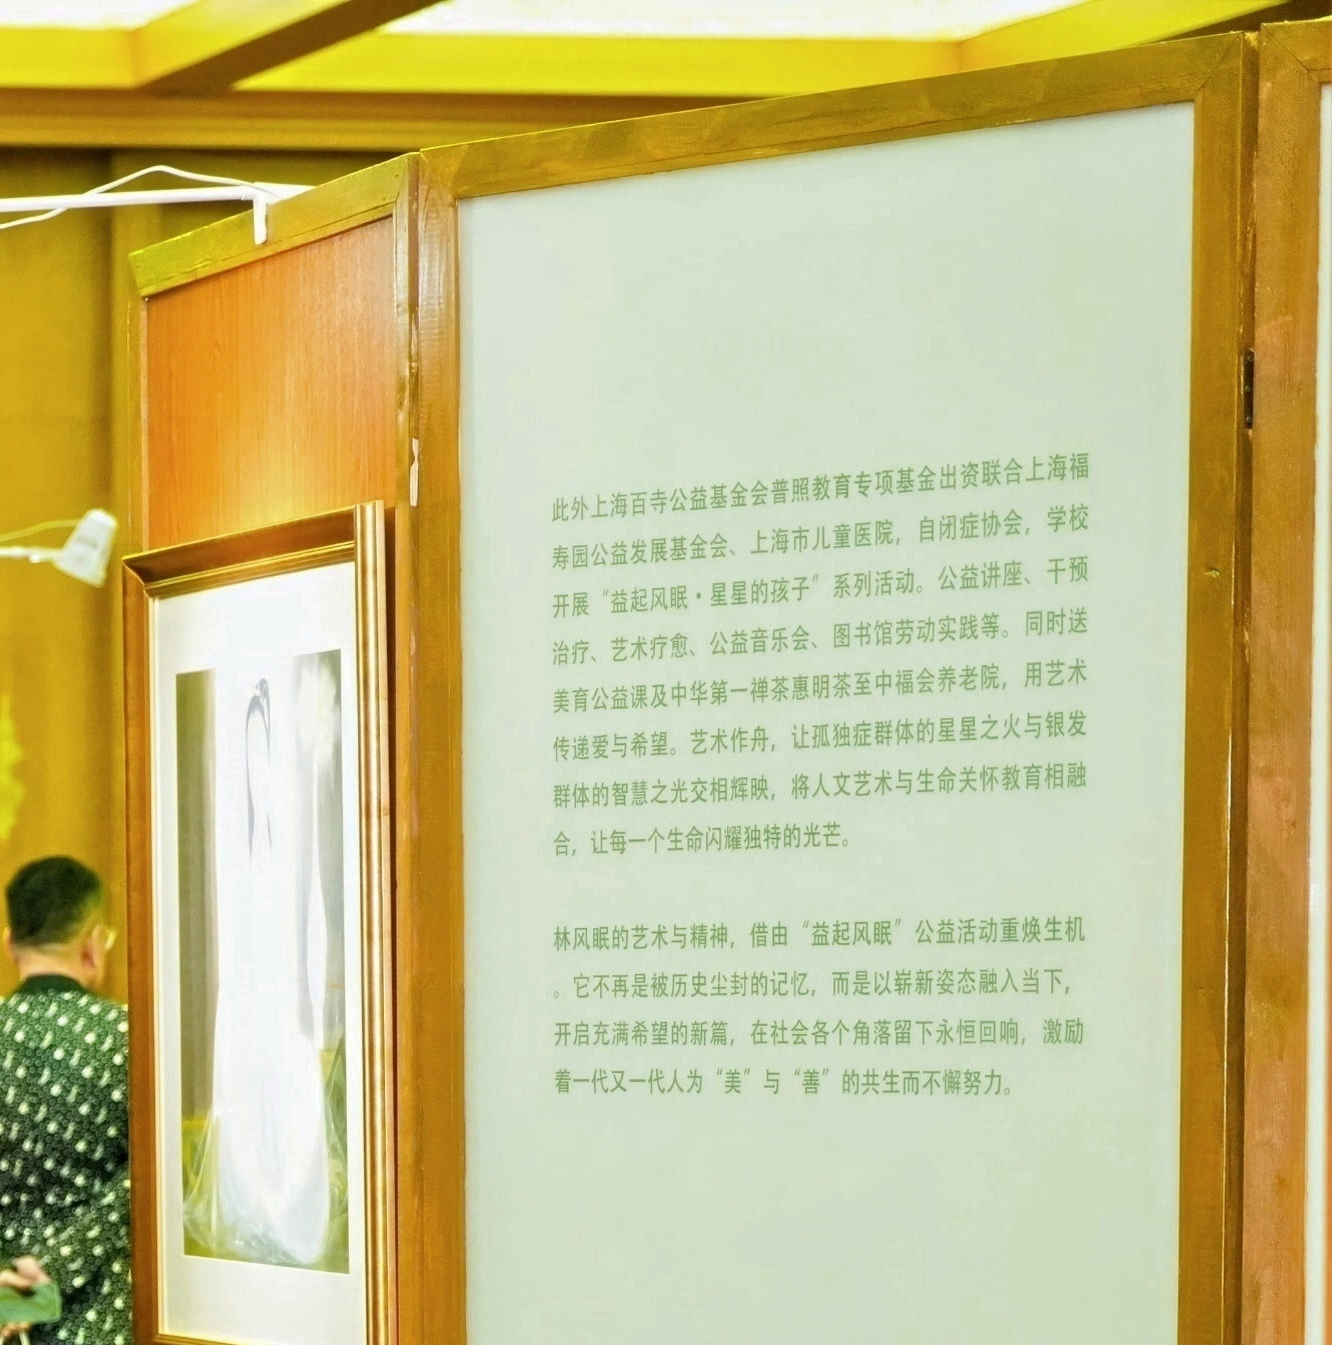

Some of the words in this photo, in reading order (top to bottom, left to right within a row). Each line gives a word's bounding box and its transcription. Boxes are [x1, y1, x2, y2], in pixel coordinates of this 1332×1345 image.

[552, 453, 1088, 521] 此外上海百寺公益基金会普照教育专项基金出资联合上海福
[553, 658, 1087, 713] 美育公益课及中华第一禅茶惠明茶至中福会养老院，用艺术
[553, 710, 1086, 762] 传递爱与希望。艺术作舟，让孤独症群体的星星之火与银发
[554, 761, 1086, 808] 群体的智慧之光交相辉映，将人文艺术与生命关怀教育相融
[554, 822, 848, 856] 合，让每一个生命闪耀独特的光芒。
[554, 1018, 1083, 1046] 开启充满希望的新篇，在社会各个角落留下永恒回响，激励
